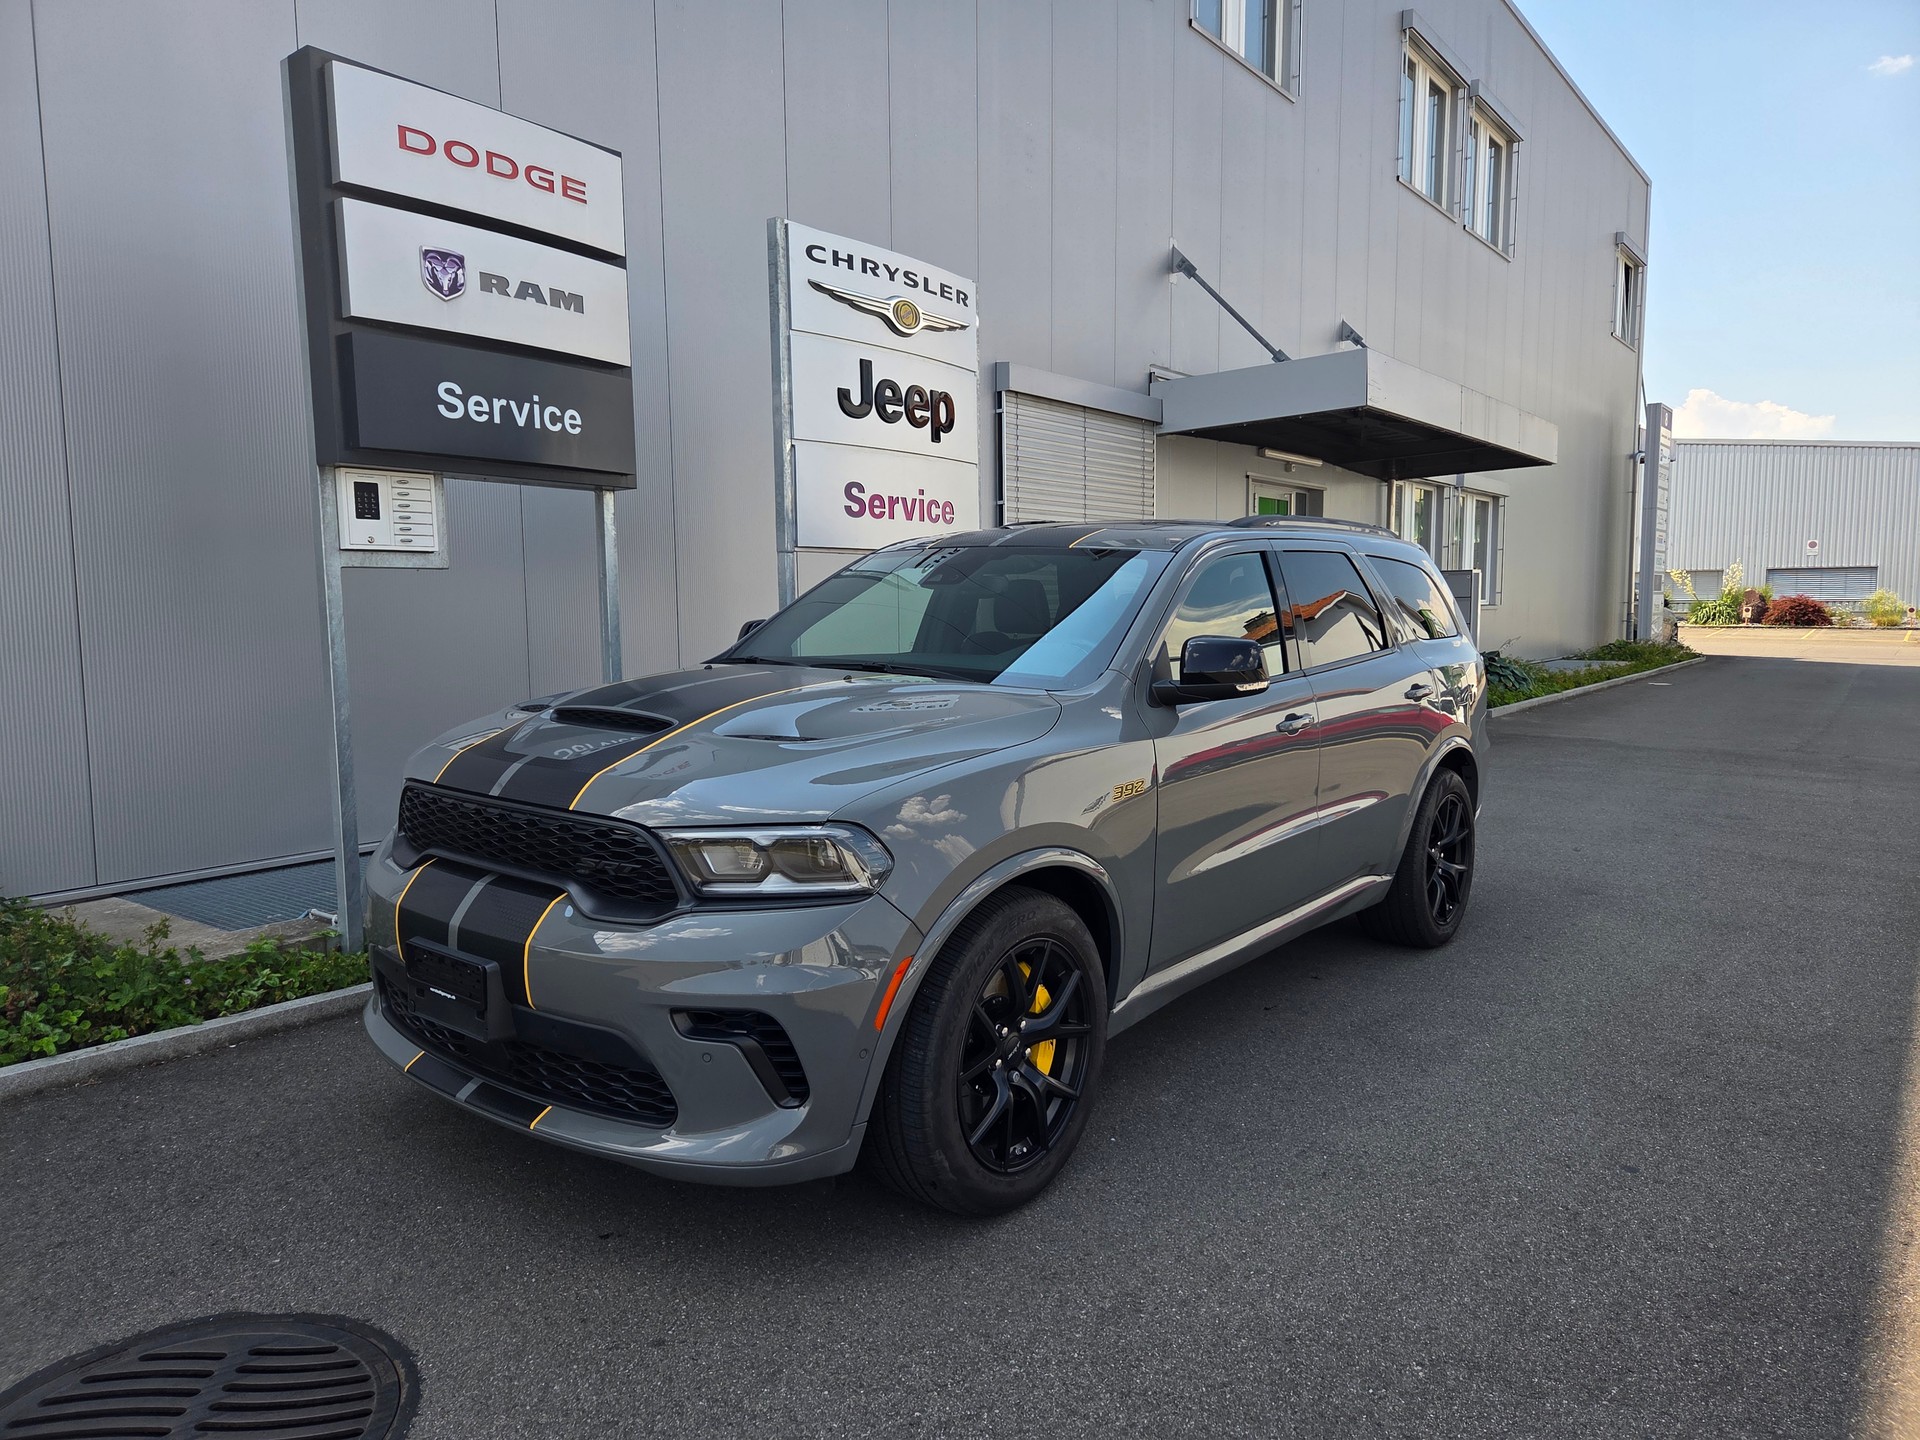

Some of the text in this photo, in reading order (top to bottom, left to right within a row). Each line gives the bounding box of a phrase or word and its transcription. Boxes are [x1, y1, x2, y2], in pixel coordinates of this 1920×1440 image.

[397, 124, 589, 205] DODGE
[478, 271, 584, 315] RAM
[805, 244, 969, 308] CHRYSLER
[437, 381, 583, 436] Service
[837, 358, 956, 443] Jeep
[843, 481, 955, 525] Service
[1113, 778, 1146, 802] 392
[998, 910, 1037, 940] ZERO
